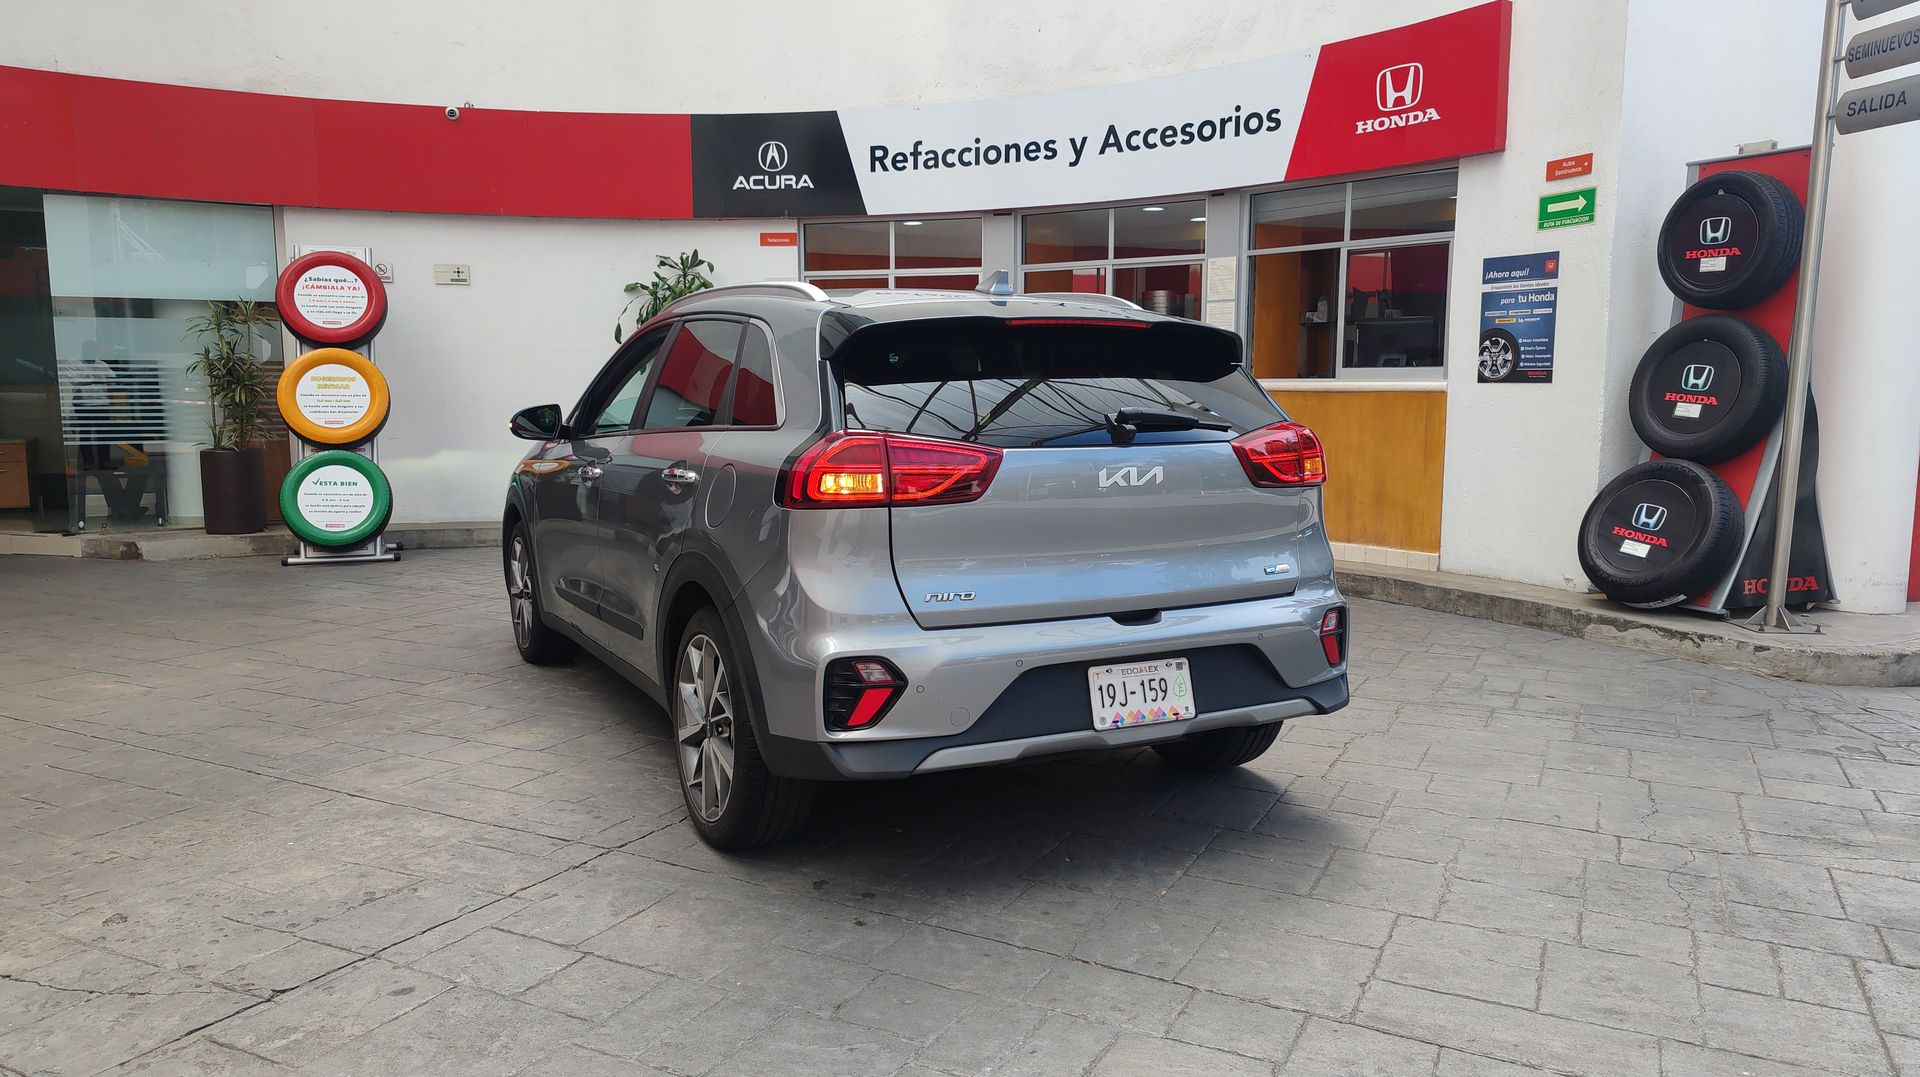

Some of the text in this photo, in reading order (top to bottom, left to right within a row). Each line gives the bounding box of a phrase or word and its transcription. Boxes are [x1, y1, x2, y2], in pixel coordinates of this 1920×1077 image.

[1847, 28, 1920, 62] SEMINUEVOS
[1846, 90, 1907, 117] SALIDA
[1356, 106, 1441, 135] HONDA
[869, 104, 1282, 173] Refacciones y Accesorios
[732, 174, 815, 190] ACURA
[1684, 247, 1742, 259] HONDA
[1500, 291, 1555, 306] para tu Honda
[1664, 392, 1718, 406] HONDA
[1099, 465, 1164, 488] KIA
[1612, 526, 1668, 547] HONDA
[1743, 575, 1820, 595] HODA
[1097, 677, 1168, 709] 19J-159
